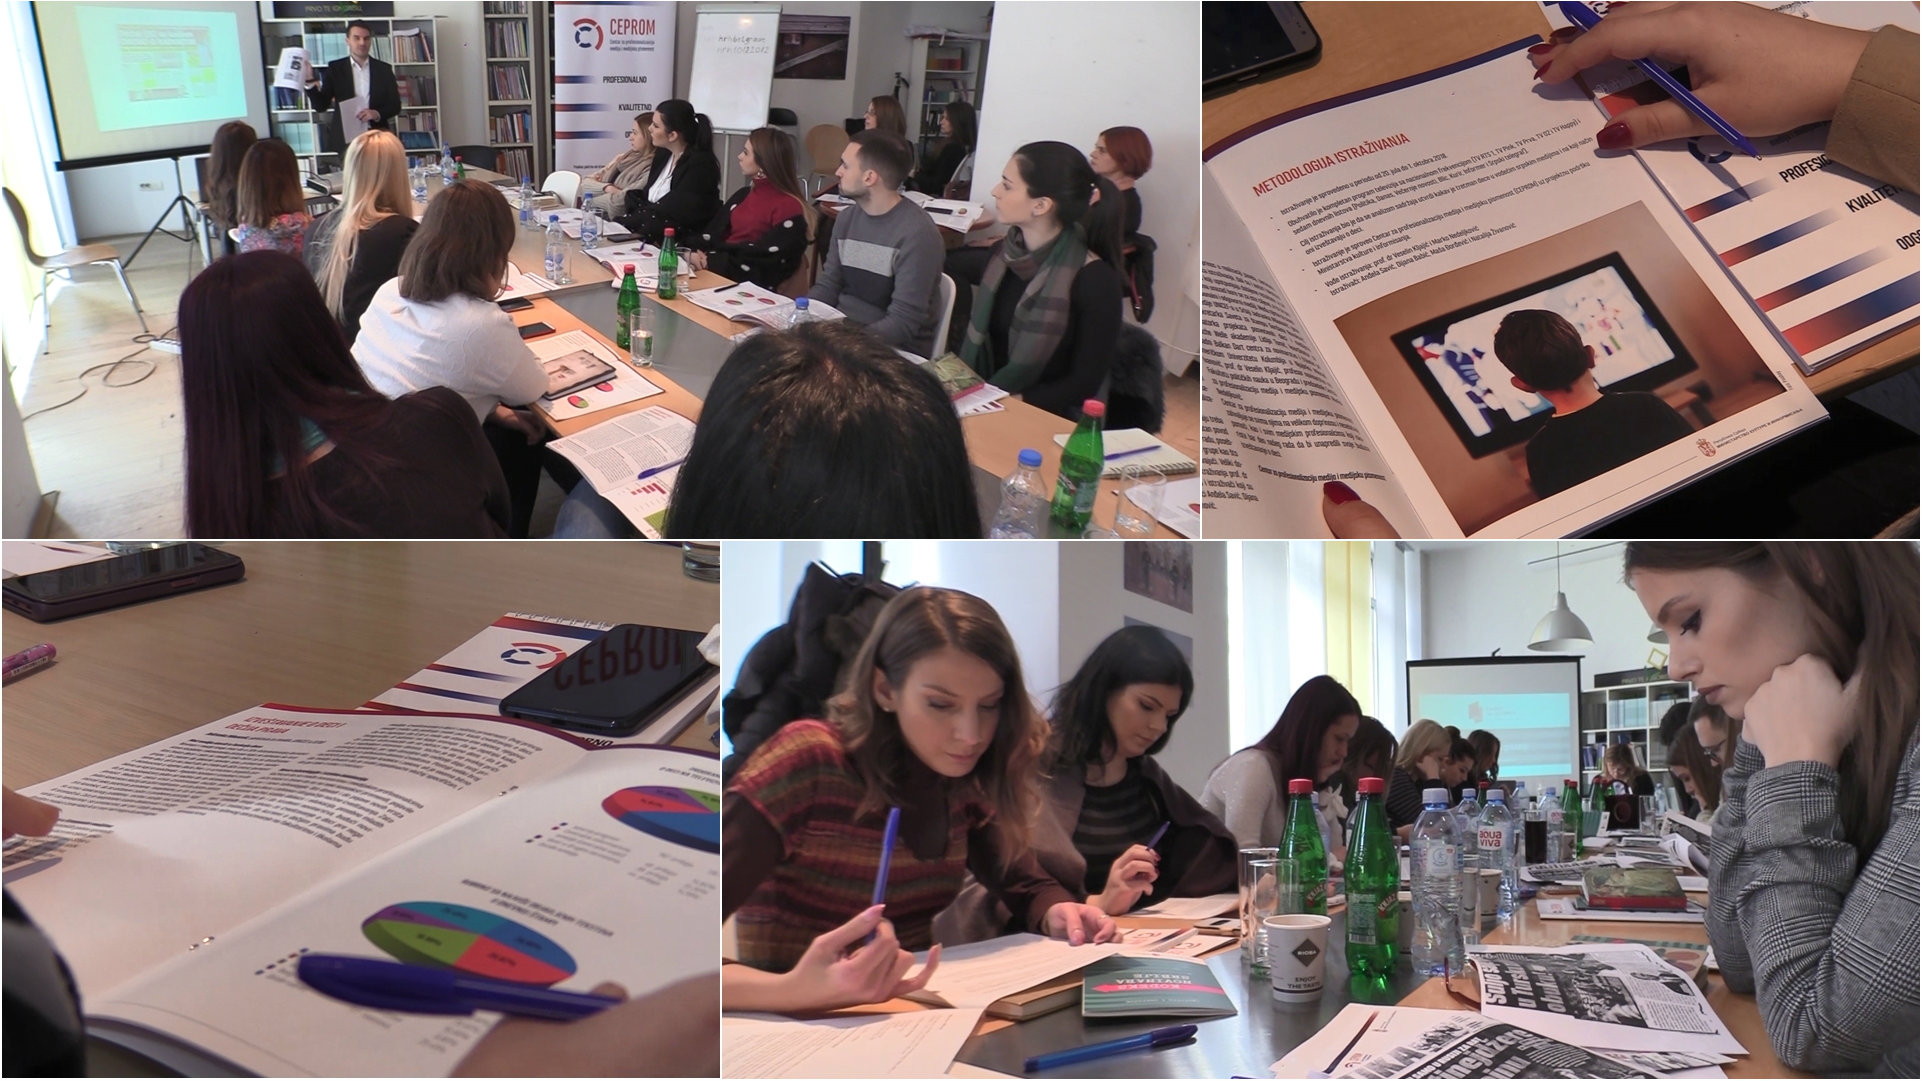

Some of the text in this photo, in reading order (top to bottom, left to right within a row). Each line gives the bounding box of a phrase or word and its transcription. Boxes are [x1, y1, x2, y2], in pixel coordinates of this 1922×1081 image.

[609, 18, 655, 35] CEPROM
[602, 75, 648, 84] PROFESIONALNO
[618, 103, 653, 112] KVALITETNO
[1252, 132, 1411, 197] METODOLOGIJA ISTRAŽIVANJA
